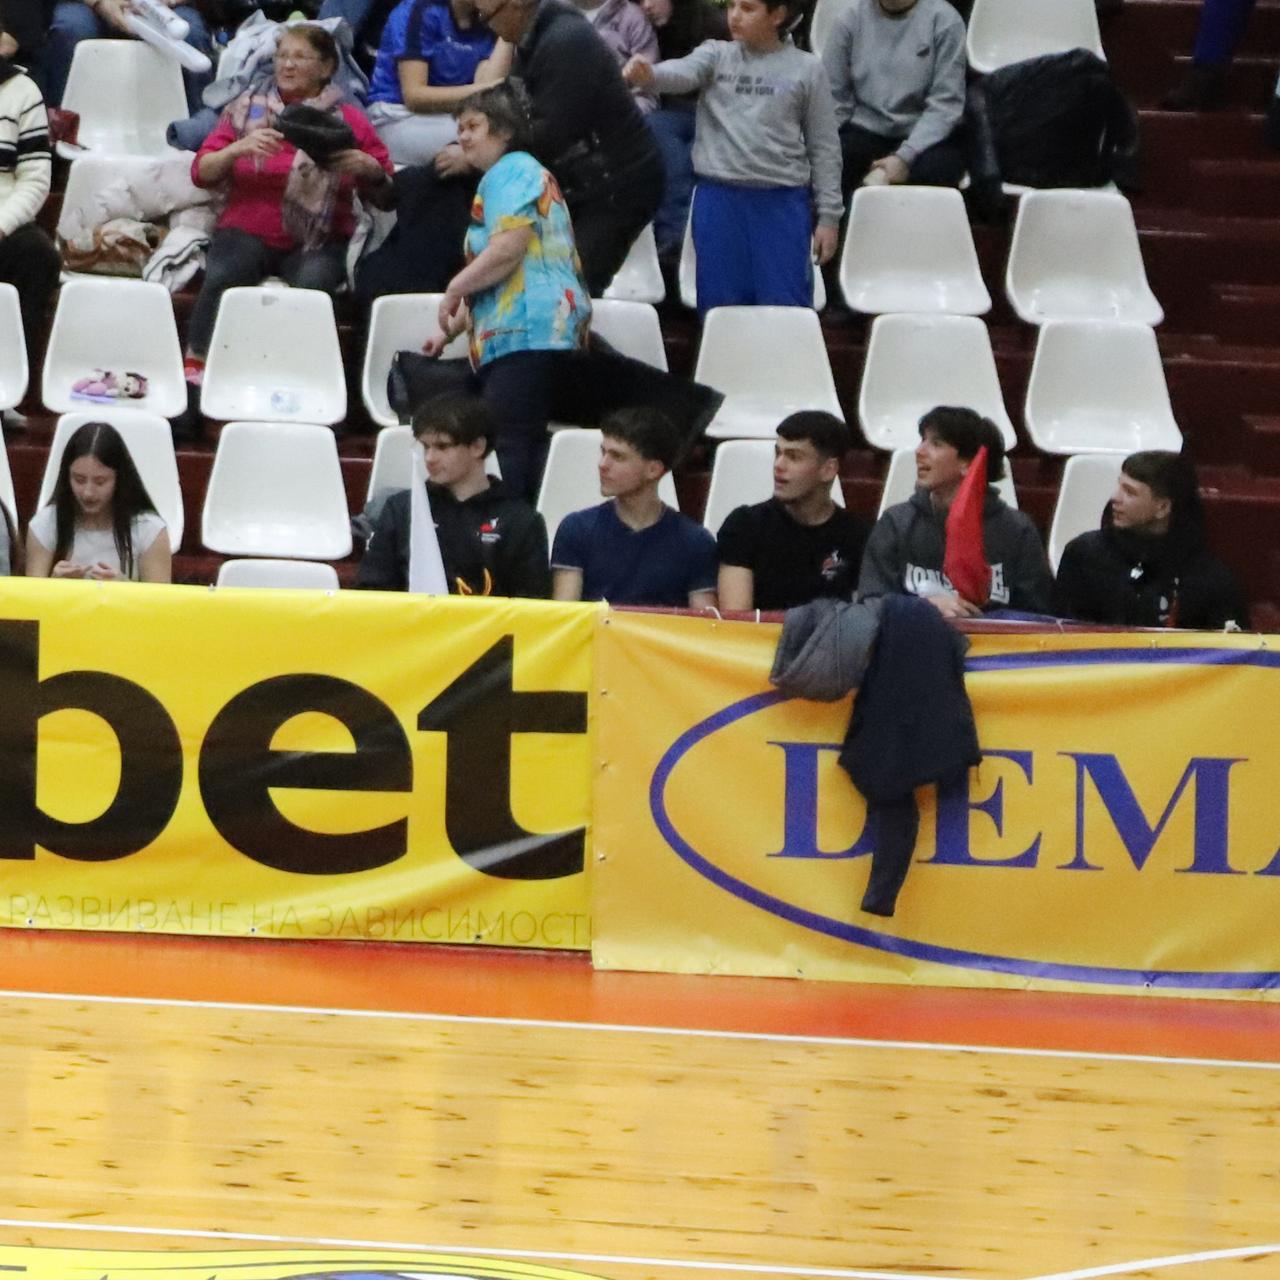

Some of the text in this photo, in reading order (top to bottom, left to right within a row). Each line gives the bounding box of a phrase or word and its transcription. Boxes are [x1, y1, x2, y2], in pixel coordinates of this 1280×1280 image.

[766, 741, 1280, 877] DEM
[8, 893, 238, 934] РАЗВИВАНЕ
[251, 902, 304, 936] НА
[315, 903, 592, 947] ЗАВИСИМОСТ
